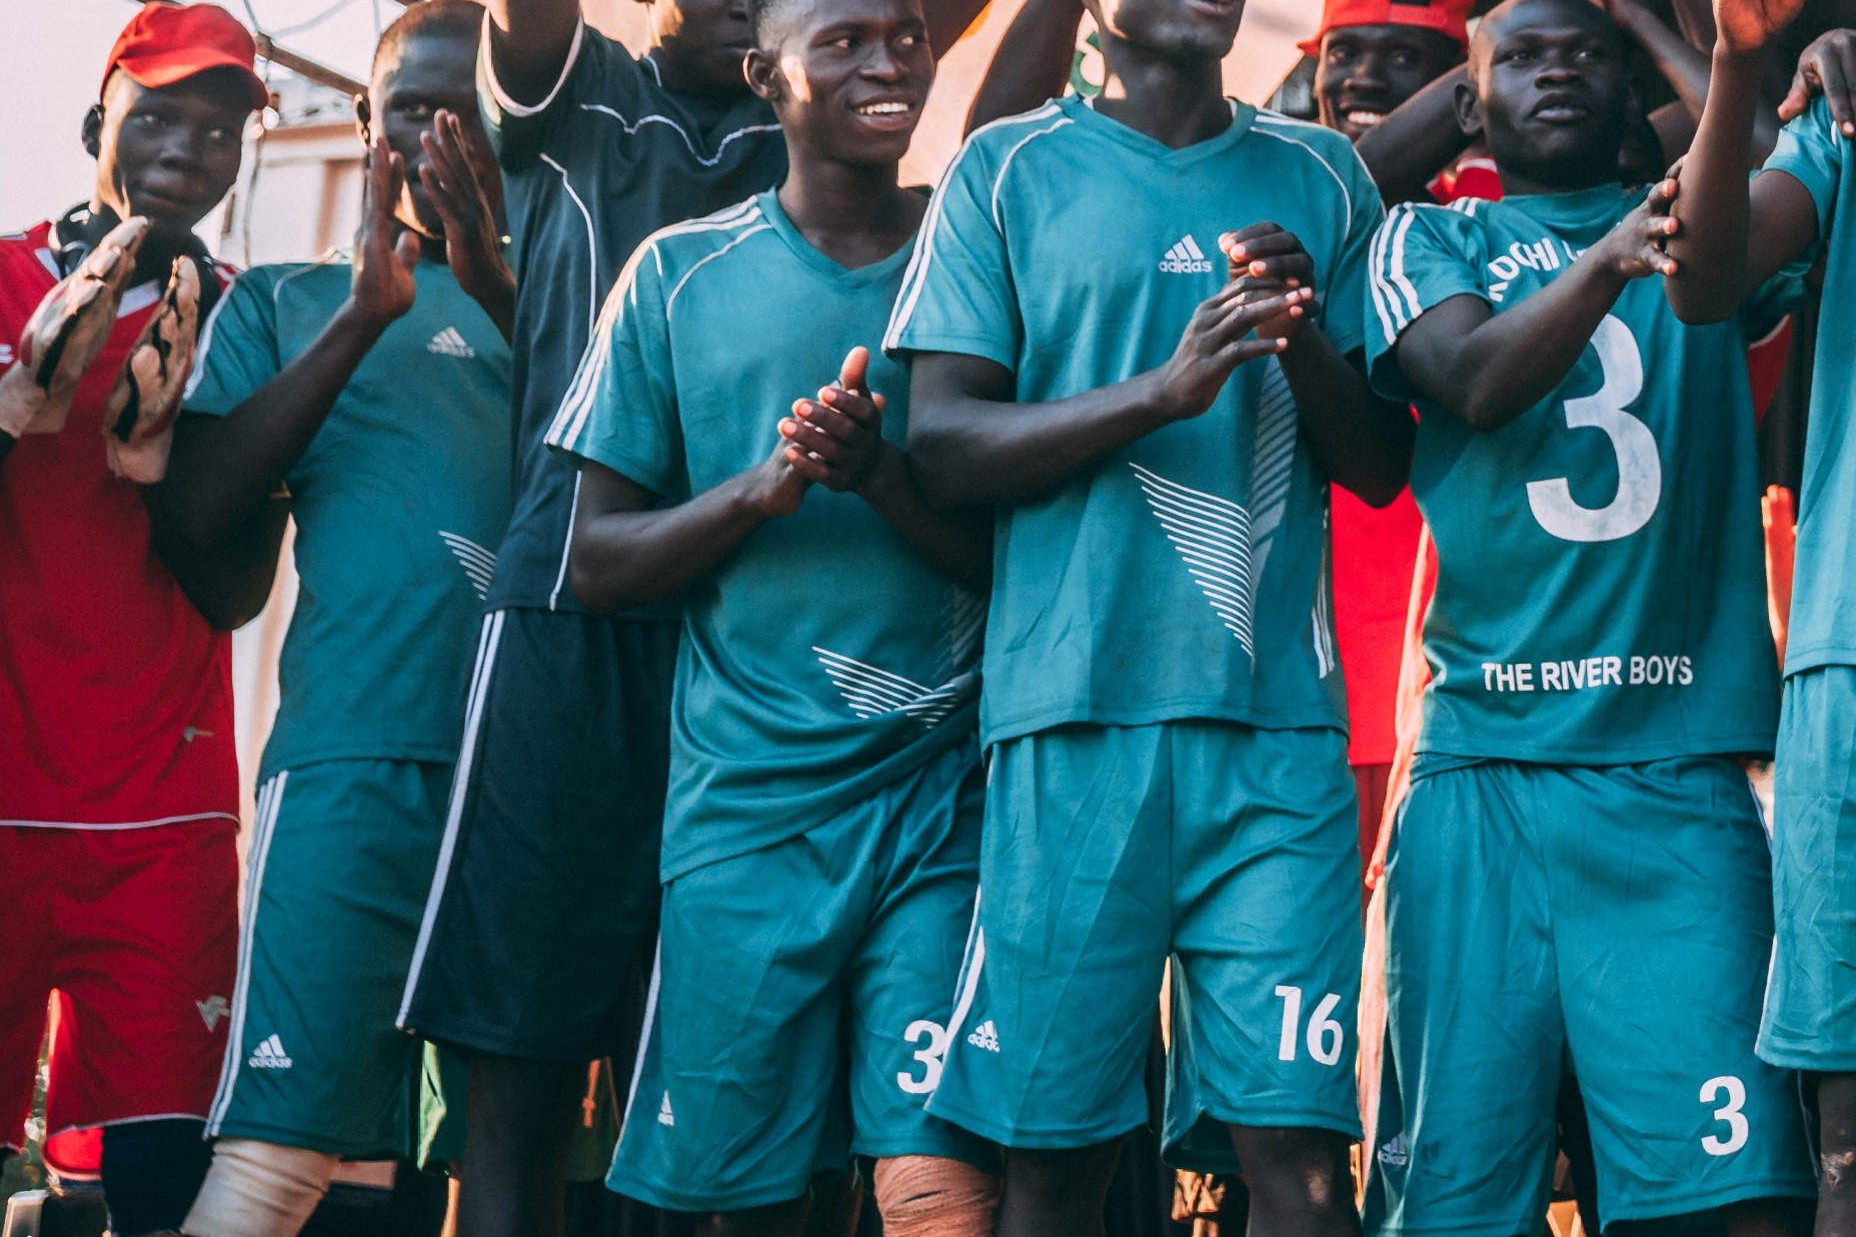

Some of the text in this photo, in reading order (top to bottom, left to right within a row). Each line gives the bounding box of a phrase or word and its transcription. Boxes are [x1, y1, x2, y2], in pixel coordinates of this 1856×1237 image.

[1159, 259, 1213, 274] adidas
[1526, 312, 1662, 542] 3
[1481, 655, 1694, 692] THE RIVER BOYS
[897, 1020, 947, 1094] 3
[1275, 985, 1344, 1066] 16
[1699, 1075, 1749, 1156] 3
